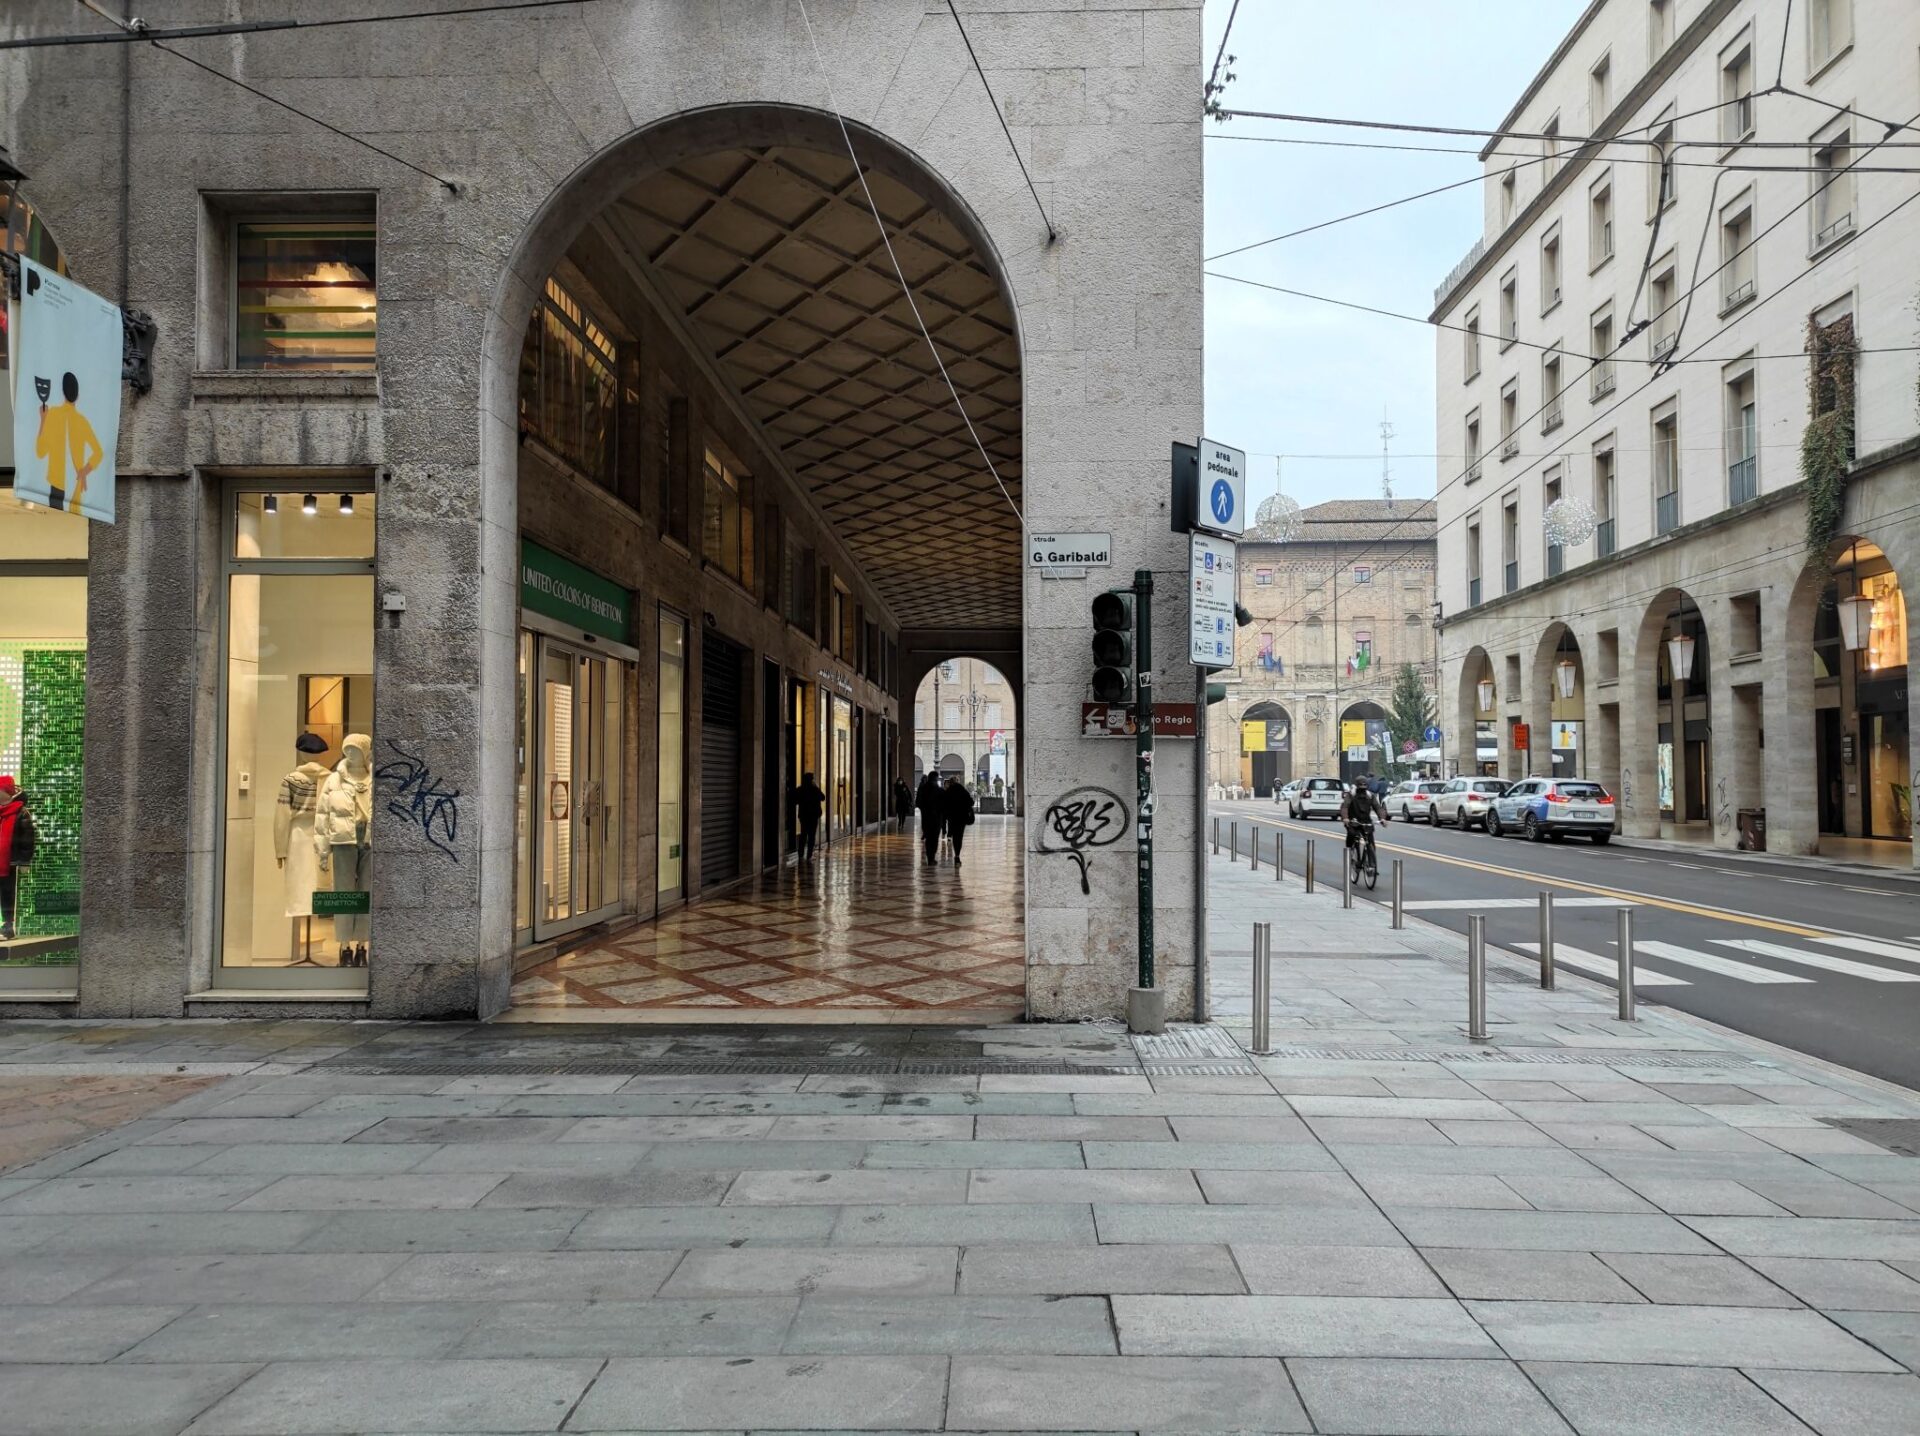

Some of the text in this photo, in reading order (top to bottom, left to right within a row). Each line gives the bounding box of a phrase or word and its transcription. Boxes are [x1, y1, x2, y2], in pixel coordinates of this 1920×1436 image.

[1215, 451, 1230, 462] area
[1207, 461, 1238, 478] pedonale
[1048, 551, 1107, 563] Garibaldi
[522, 565, 552, 594] UNITED
[552, 580, 581, 607] COLORS
[581, 592, 591, 611] OF
[1164, 715, 1192, 726] Regio
